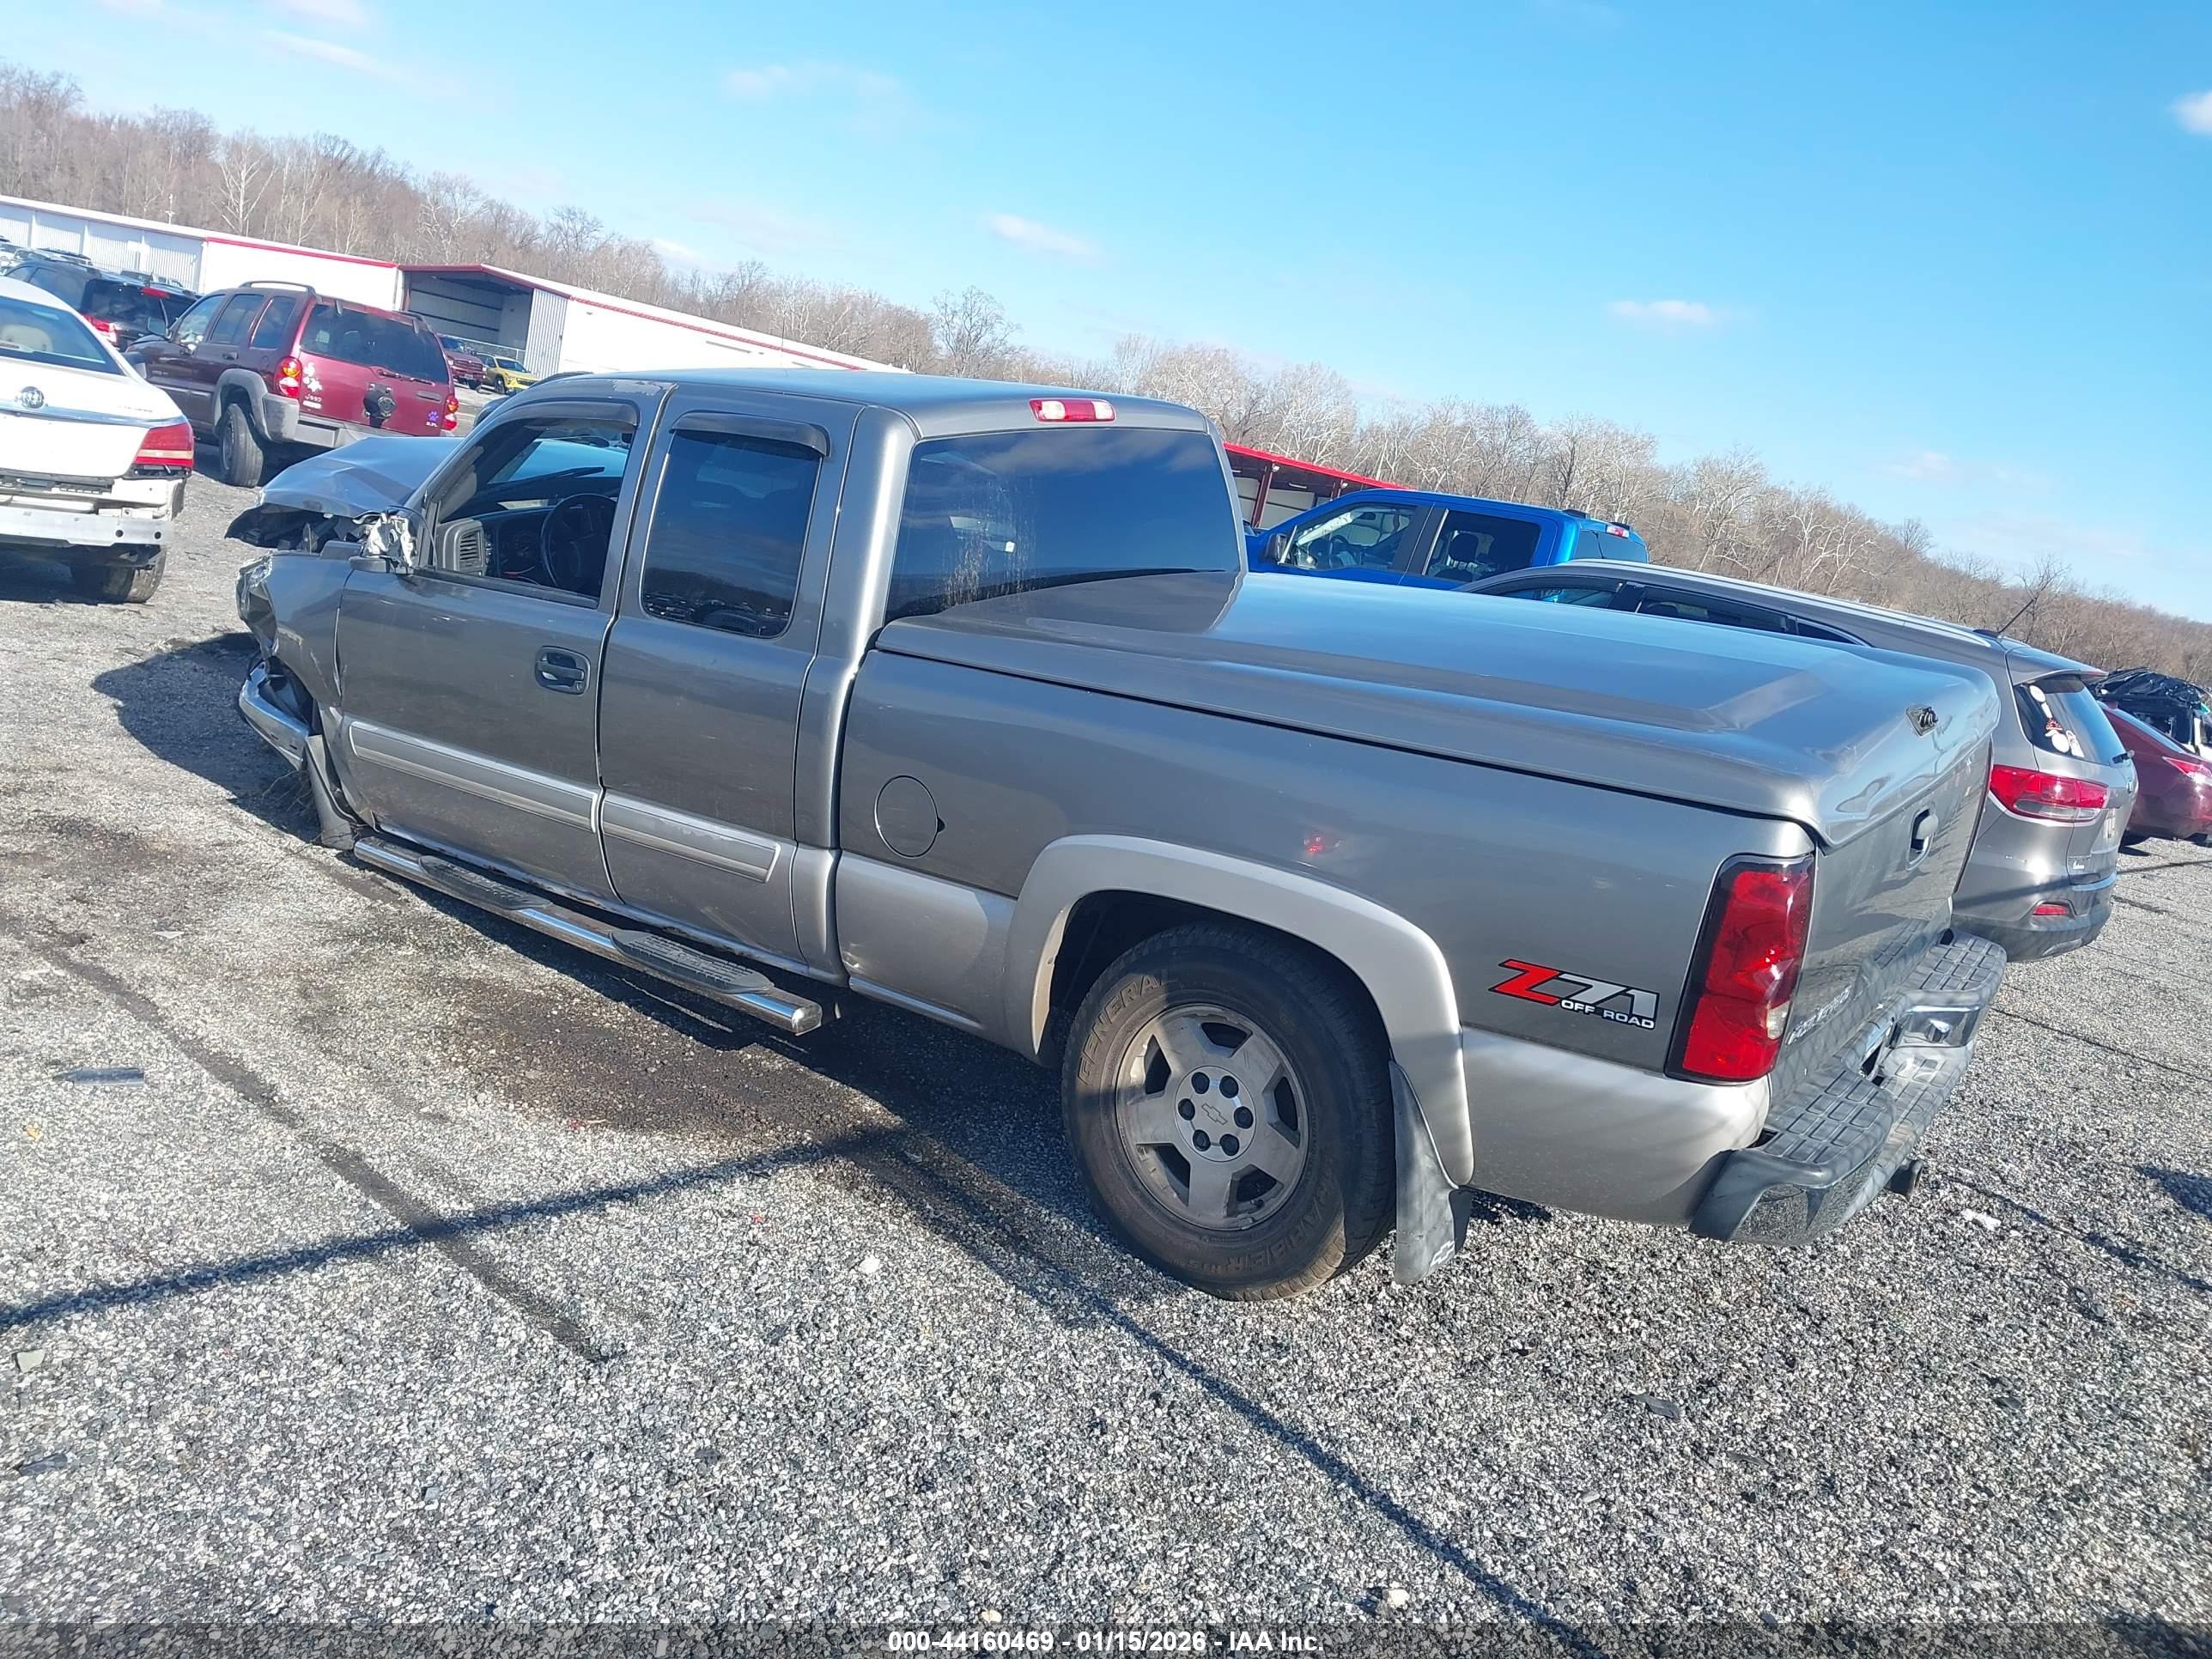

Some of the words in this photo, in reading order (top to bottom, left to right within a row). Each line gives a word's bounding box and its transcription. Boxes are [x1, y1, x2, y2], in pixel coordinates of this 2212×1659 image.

[1488, 958, 1660, 1019] Z71
[1561, 999, 1595, 1014] OFF
[1602, 1009, 1655, 1030] ROAD
